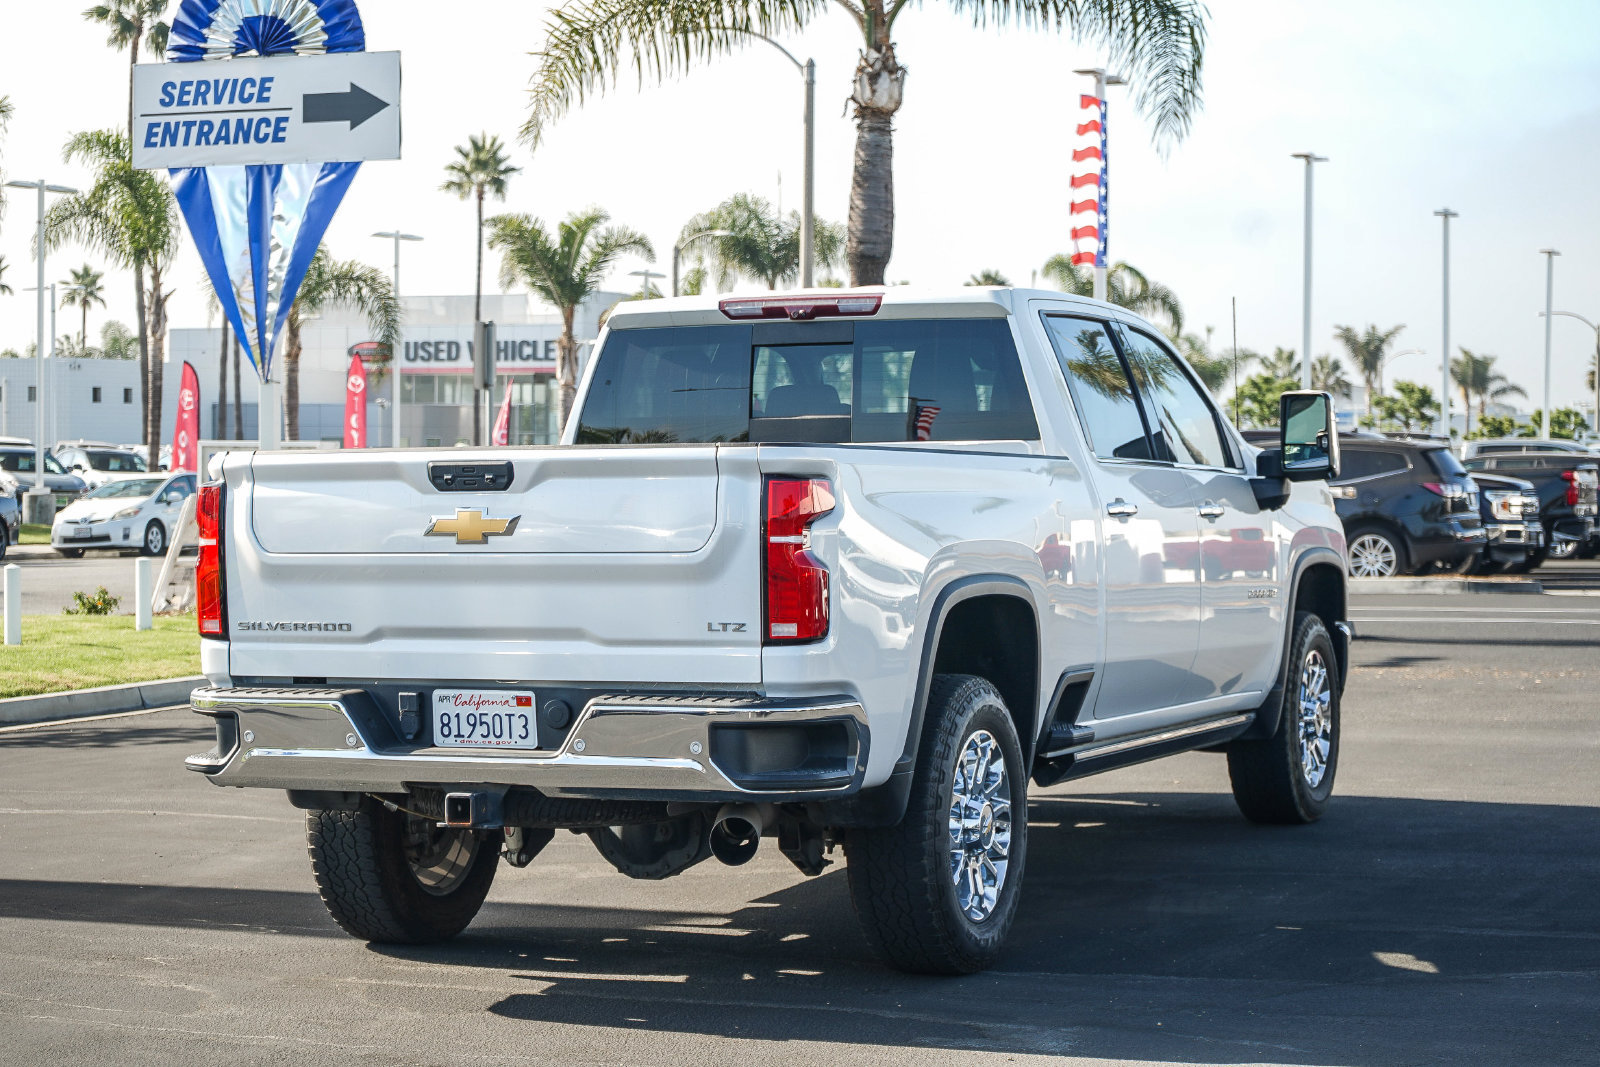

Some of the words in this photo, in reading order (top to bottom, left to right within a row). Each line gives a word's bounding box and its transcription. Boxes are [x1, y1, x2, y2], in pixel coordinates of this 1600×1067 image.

[159, 76, 274, 108] SERVICE
[143, 116, 289, 149] ENTRANCE
[404, 340, 460, 362] USED
[466, 340, 557, 362] VHICLE
[237, 621, 352, 632] SILVERADO
[707, 621, 747, 632] LTZ
[438, 695, 451, 704] APR
[453, 693, 516, 711] California
[440, 712, 529, 740] 81950T3
